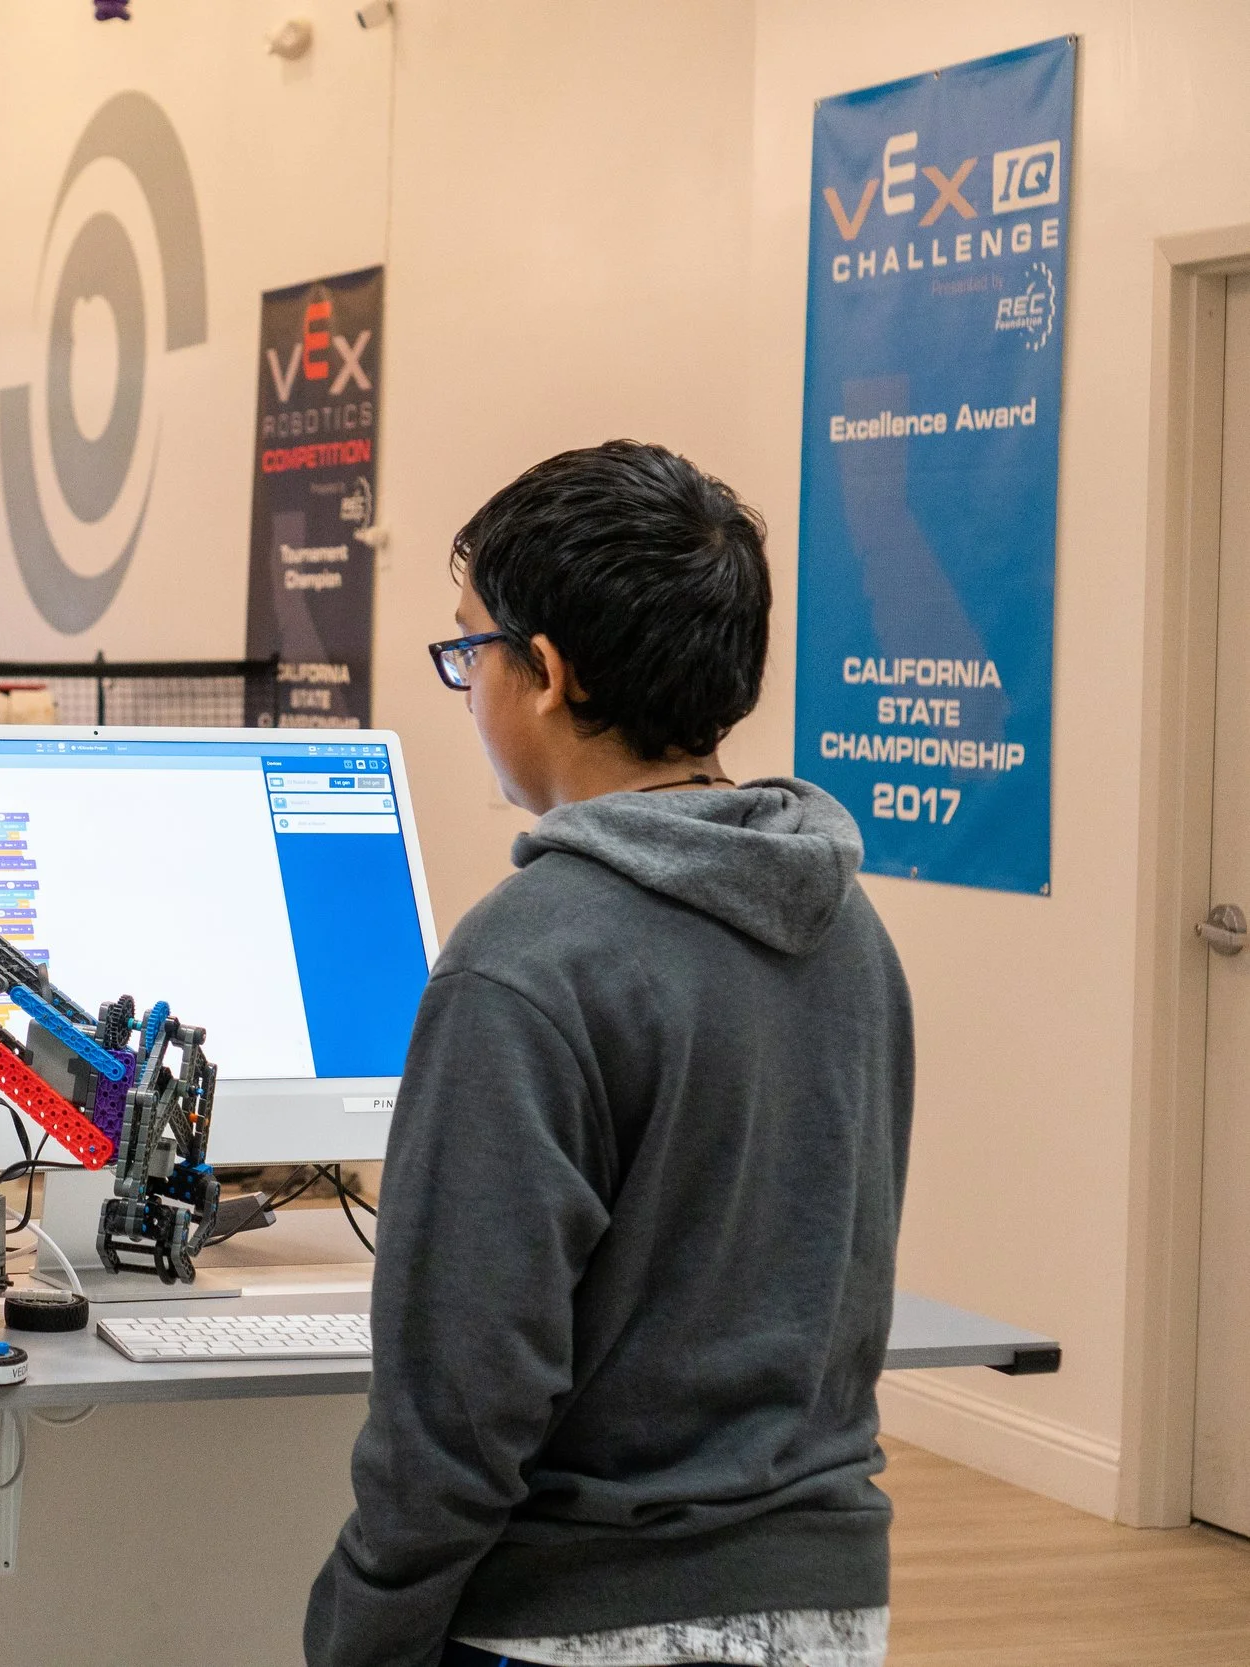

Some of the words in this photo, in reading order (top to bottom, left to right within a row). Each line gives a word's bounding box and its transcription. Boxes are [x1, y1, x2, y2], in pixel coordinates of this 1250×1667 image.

[822, 130, 979, 241] VEX
[998, 151, 1055, 203] IQ
[832, 218, 1059, 283] CHALLENGE
[997, 292, 1046, 319] REC
[266, 301, 373, 404] VEX
[261, 401, 373, 439] ROBOTICS
[829, 411, 948, 442] Excellence
[955, 397, 1037, 431] Award
[261, 439, 372, 473] COMPETITION
[842, 657, 1002, 688] CALIFORNIA
[877, 697, 961, 727] STATE
[820, 731, 1026, 772] CHAMPIONSHIP
[872, 782, 962, 825] 2017
[373, 1100, 394, 1108] PIN
